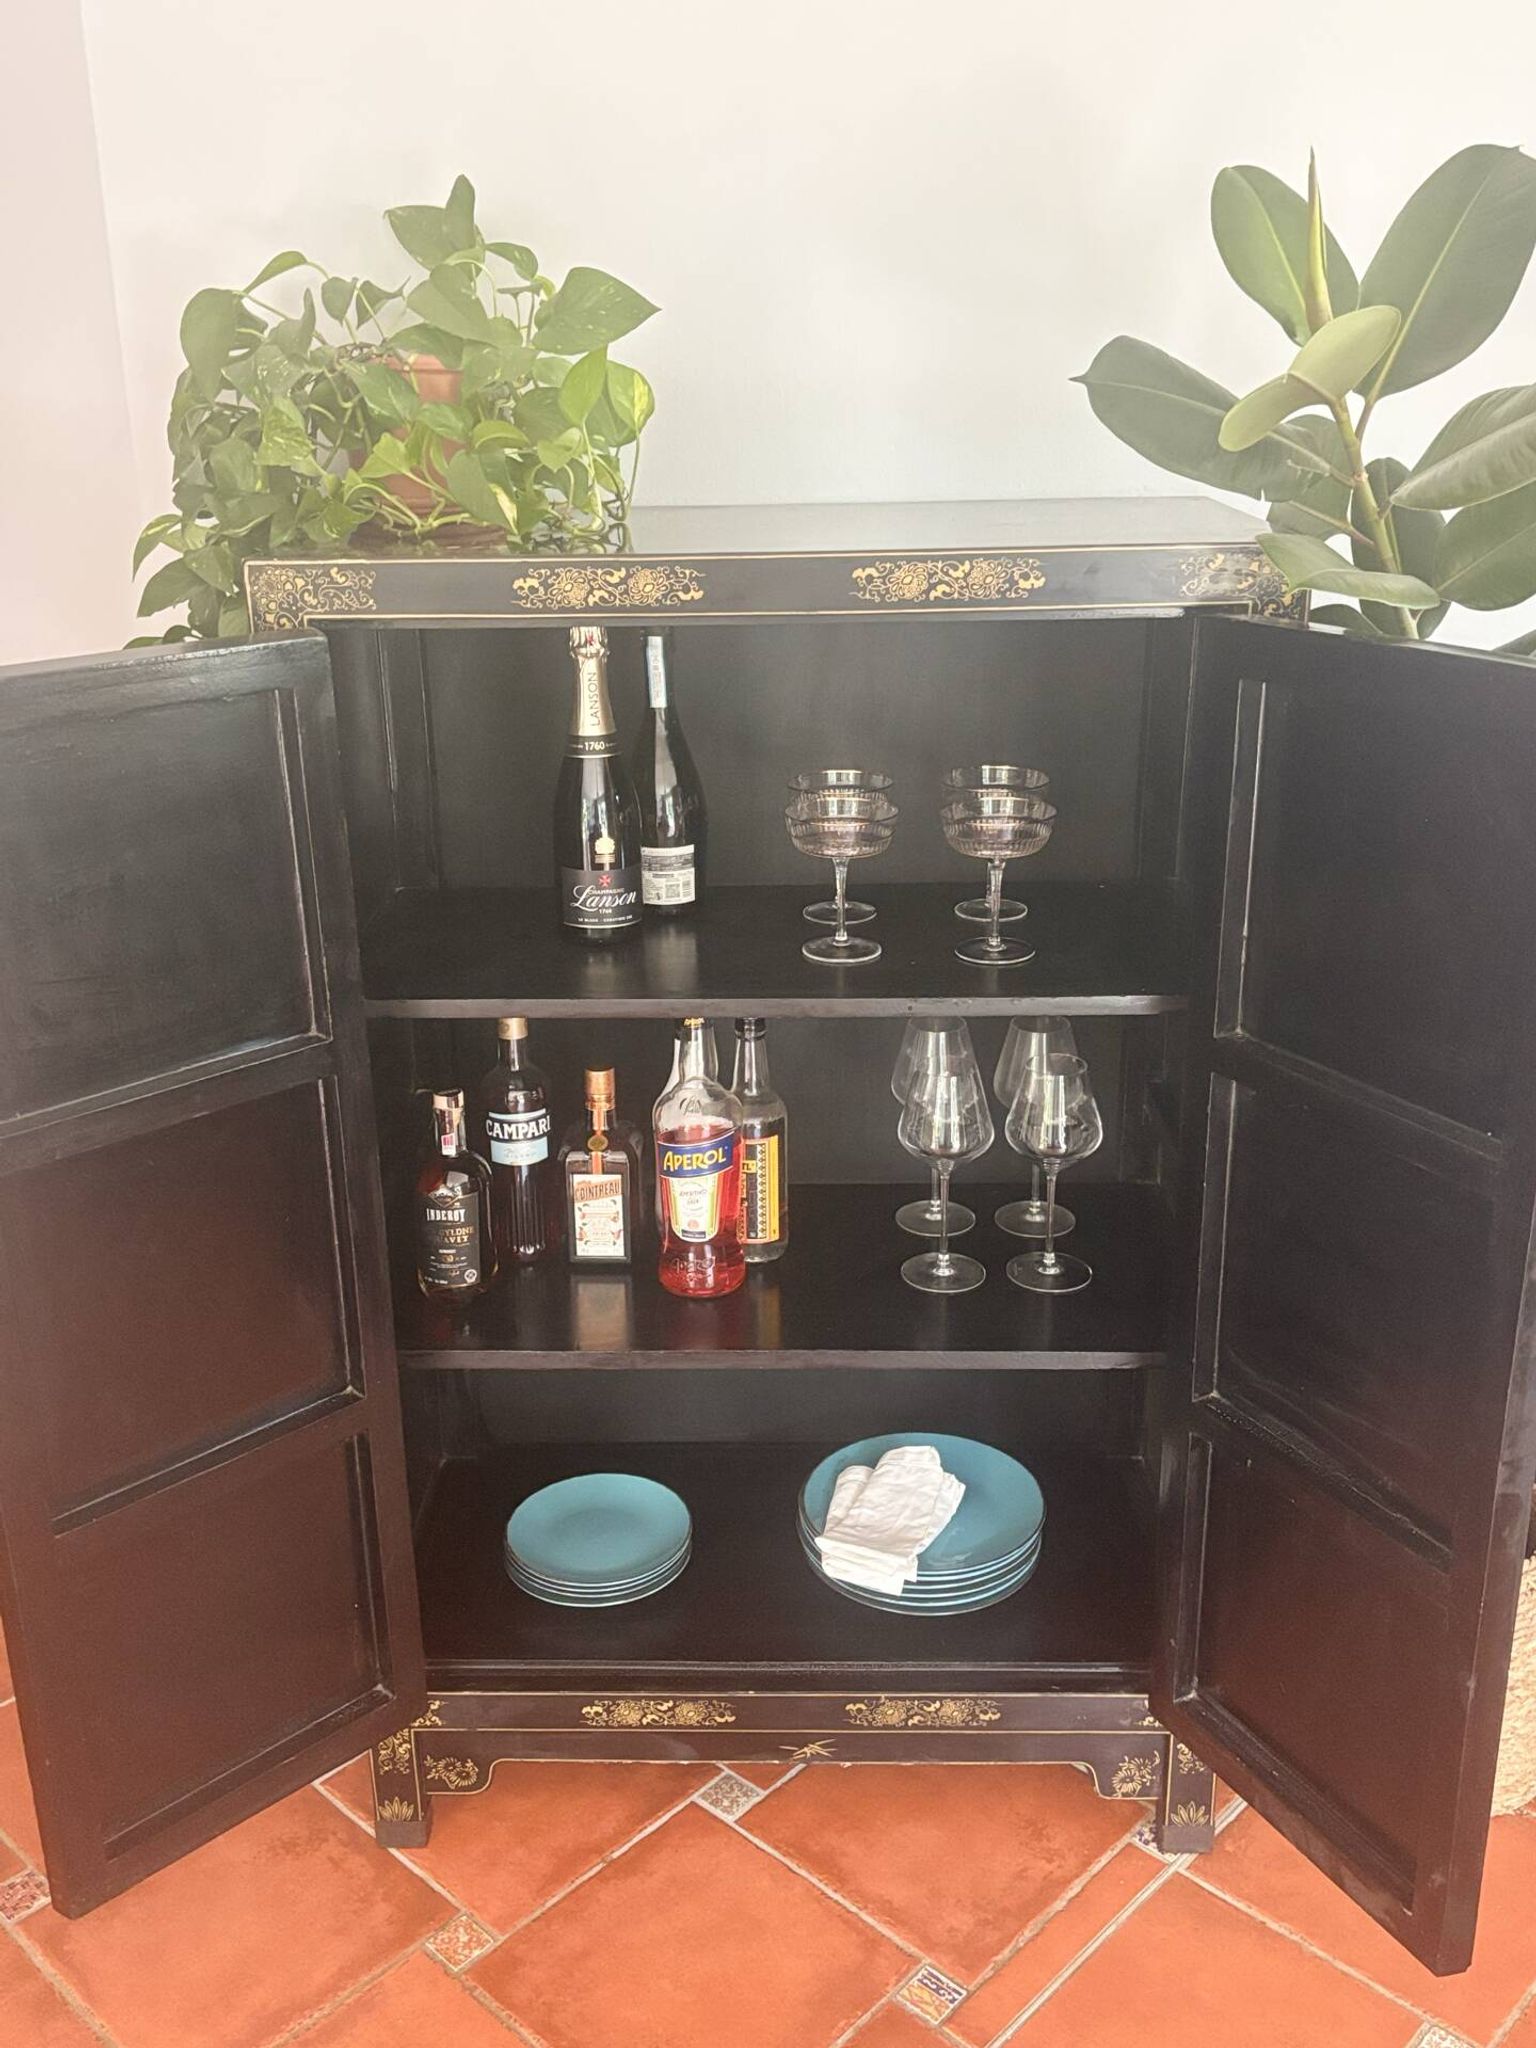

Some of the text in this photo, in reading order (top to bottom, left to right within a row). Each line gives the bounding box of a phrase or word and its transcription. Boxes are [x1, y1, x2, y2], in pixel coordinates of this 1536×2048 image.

[588, 672, 601, 726] LANSON
[584, 741, 605, 751] 1760
[570, 884, 637, 912] Lanson
[485, 1115, 551, 1140] CAMPARI
[663, 1147, 727, 1172] APEROL
[575, 1180, 621, 1201] COINTREAU
